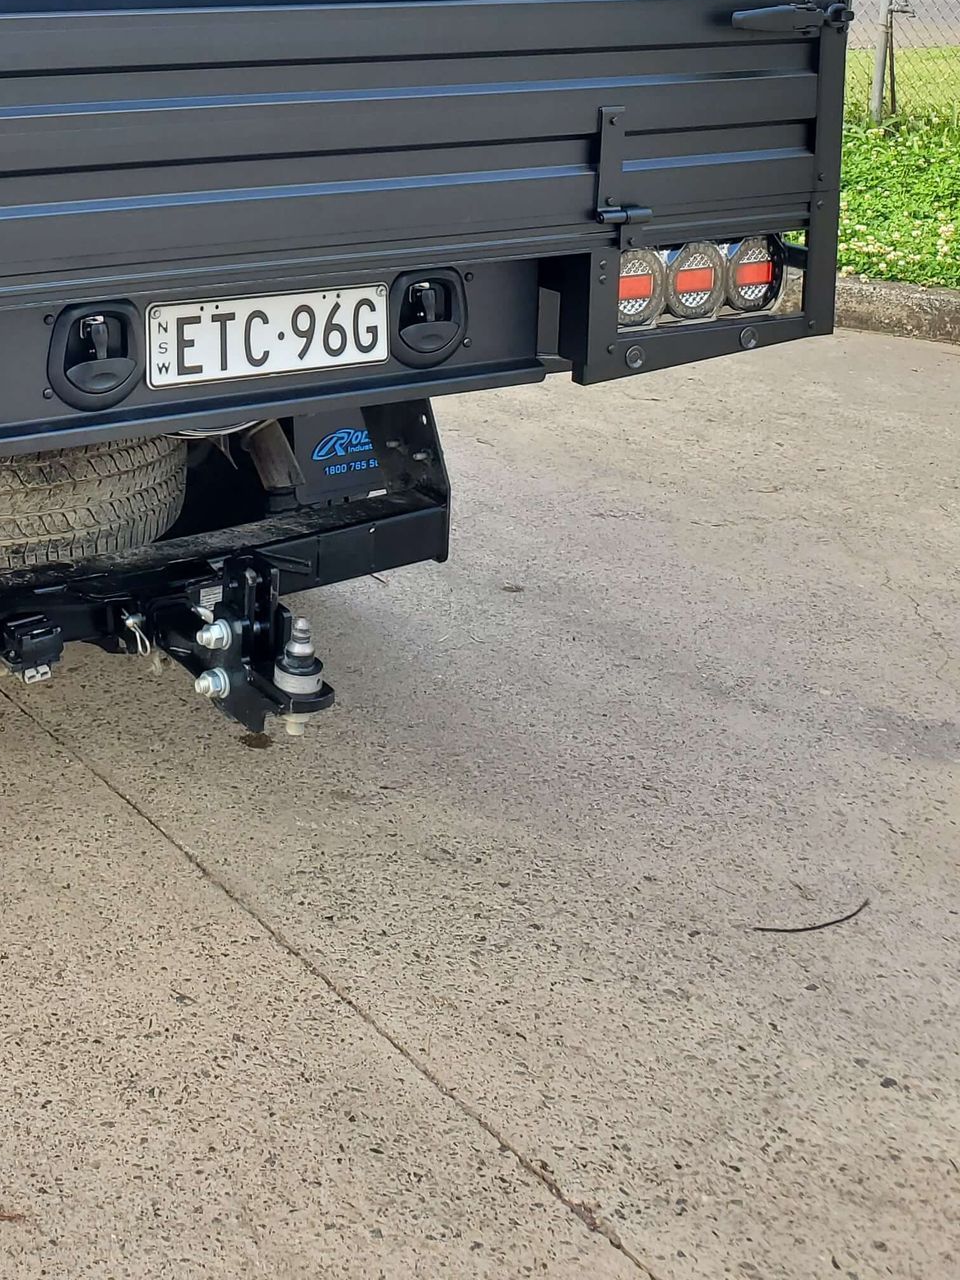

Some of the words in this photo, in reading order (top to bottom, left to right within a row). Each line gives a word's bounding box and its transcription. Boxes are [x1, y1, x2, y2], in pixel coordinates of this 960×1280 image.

[312, 429, 371, 460] ROL
[348, 444, 373, 453] Indust
[325, 464, 347, 476] 1800
[350, 462, 367, 471] 765
